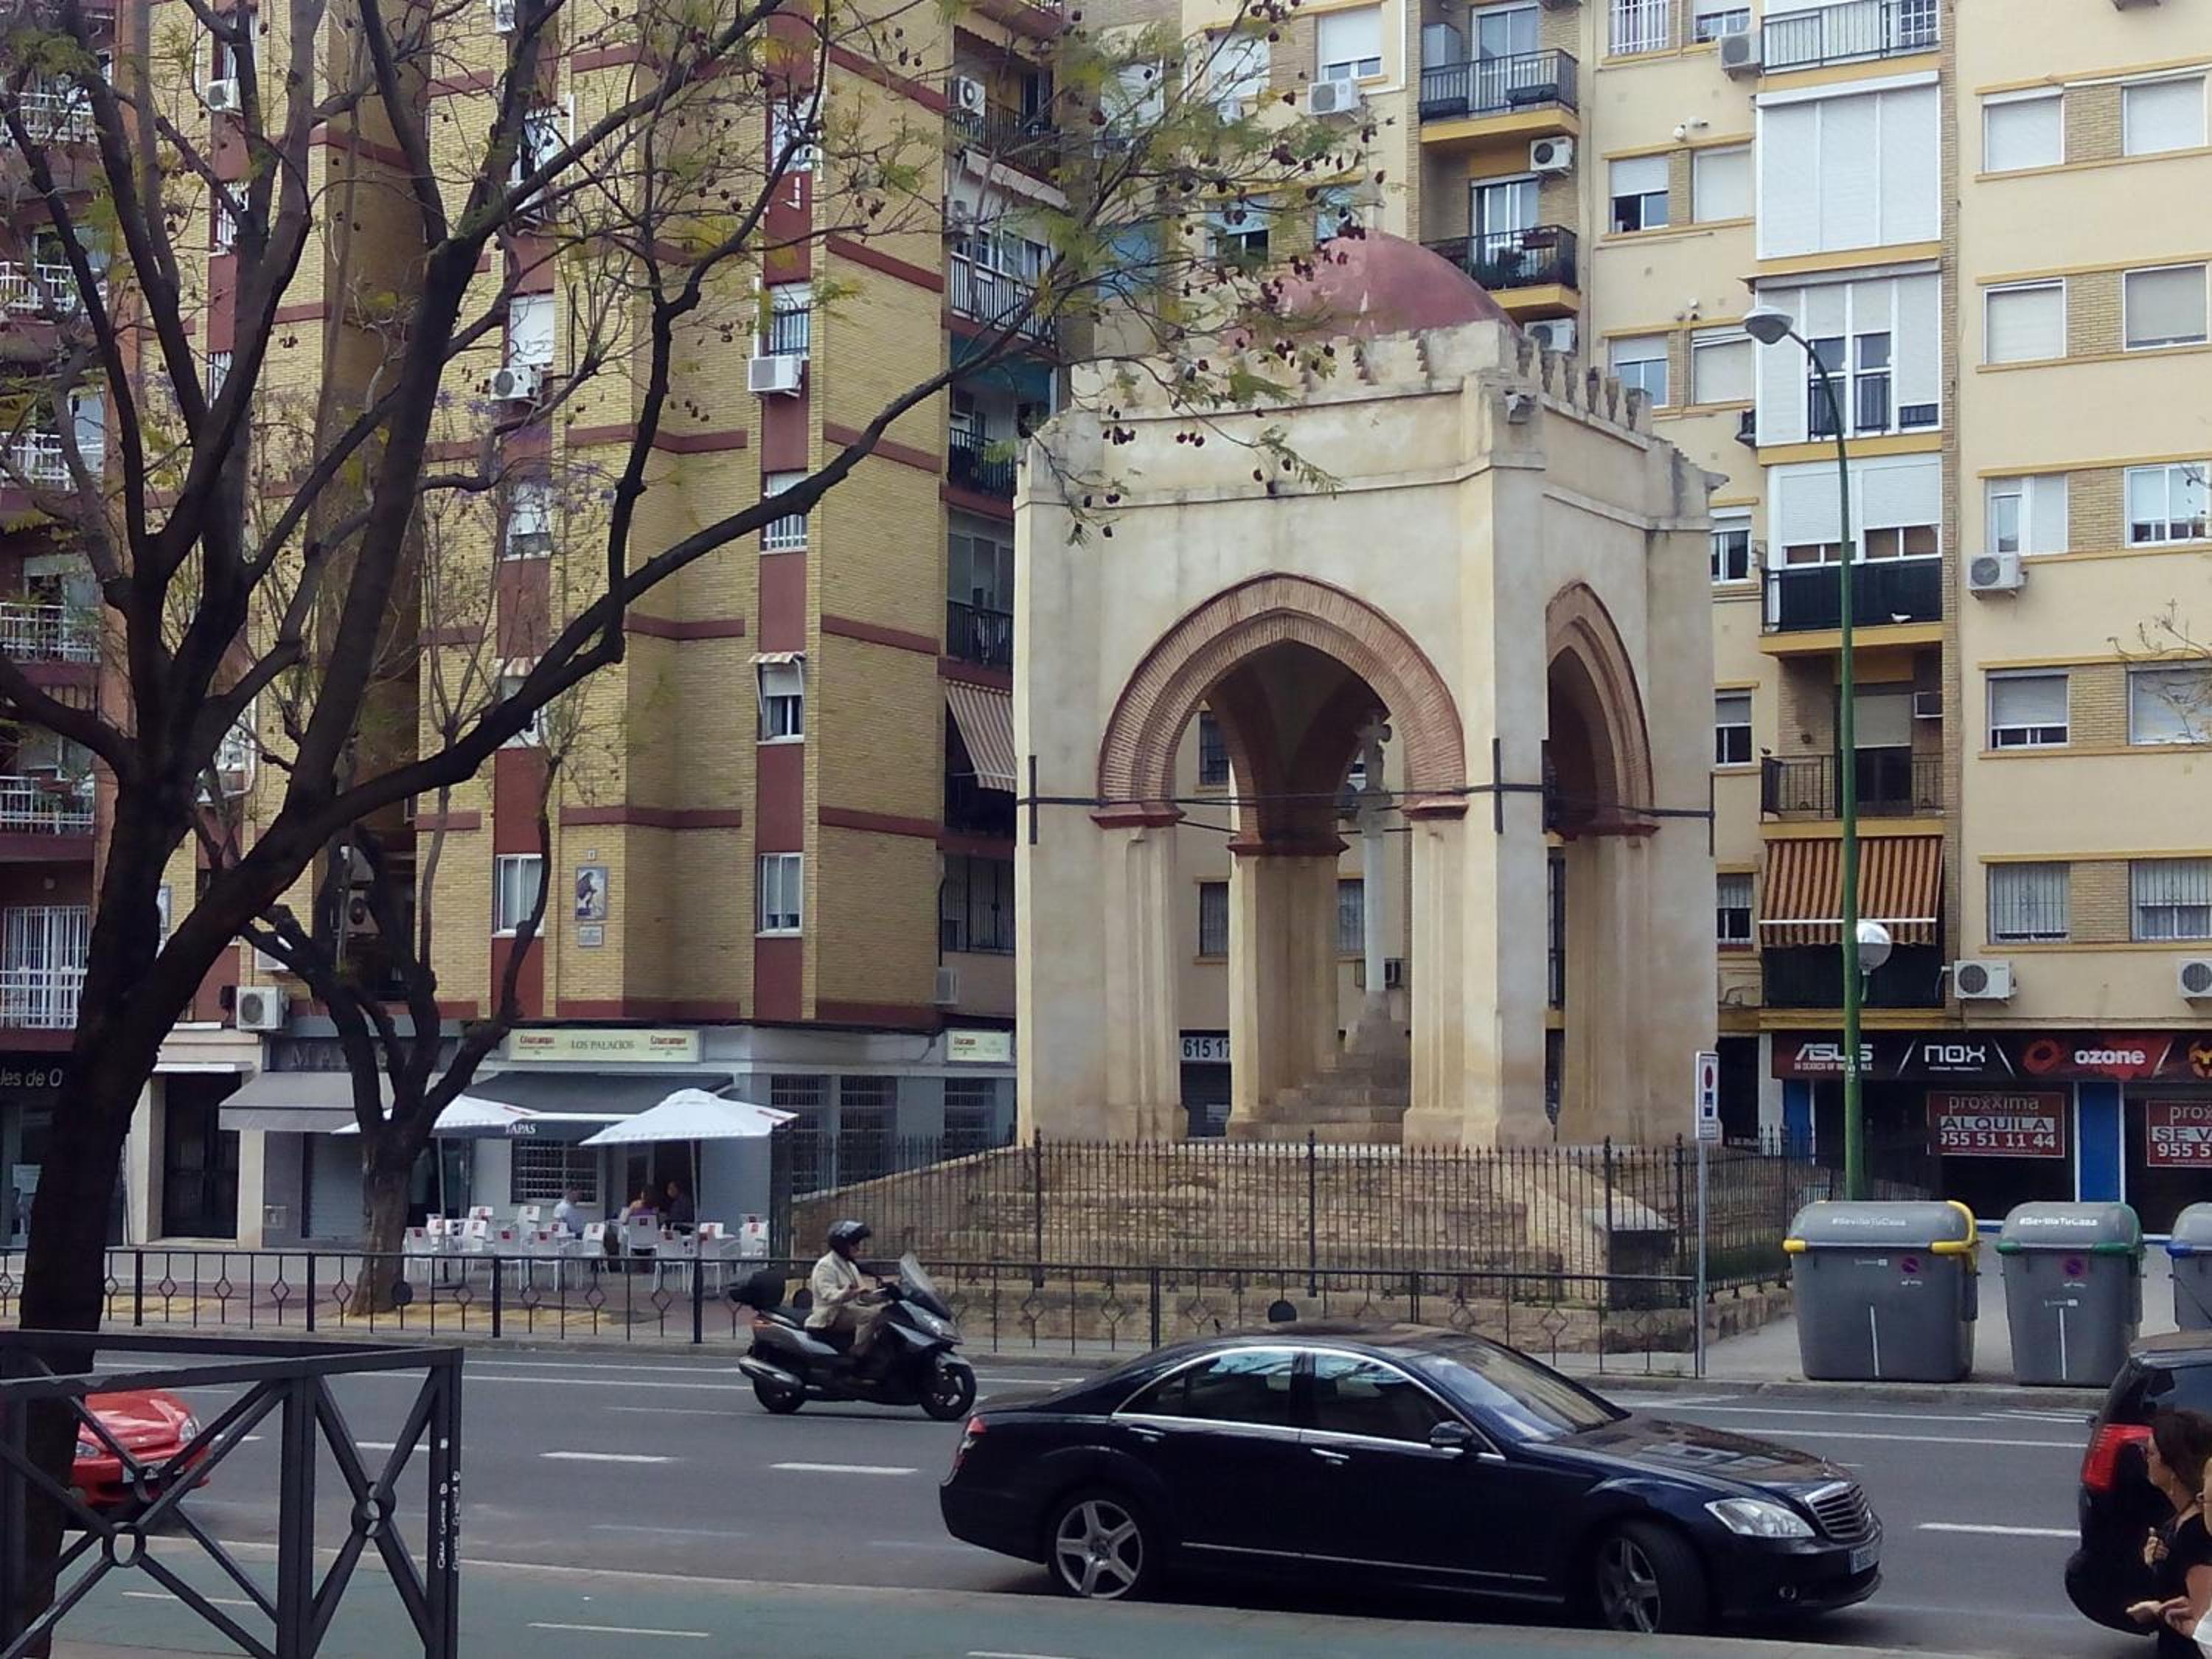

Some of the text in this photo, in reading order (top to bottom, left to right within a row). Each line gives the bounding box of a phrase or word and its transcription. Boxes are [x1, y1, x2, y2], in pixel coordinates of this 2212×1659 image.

[571, 1040, 588, 1049] LOS
[1183, 1039, 1211, 1057] 615
[2074, 1050, 2146, 1064] ozone
[26, 1068, 45, 1087] de
[1942, 1117, 2048, 1131] ALQUILA
[1976, 1133, 1998, 1147] 51
[2006, 1133, 2027, 1147] 11
[2032, 1133, 2056, 1148] 44
[2157, 1127, 2188, 1142] SE
[2157, 1144, 2194, 1158] 955
